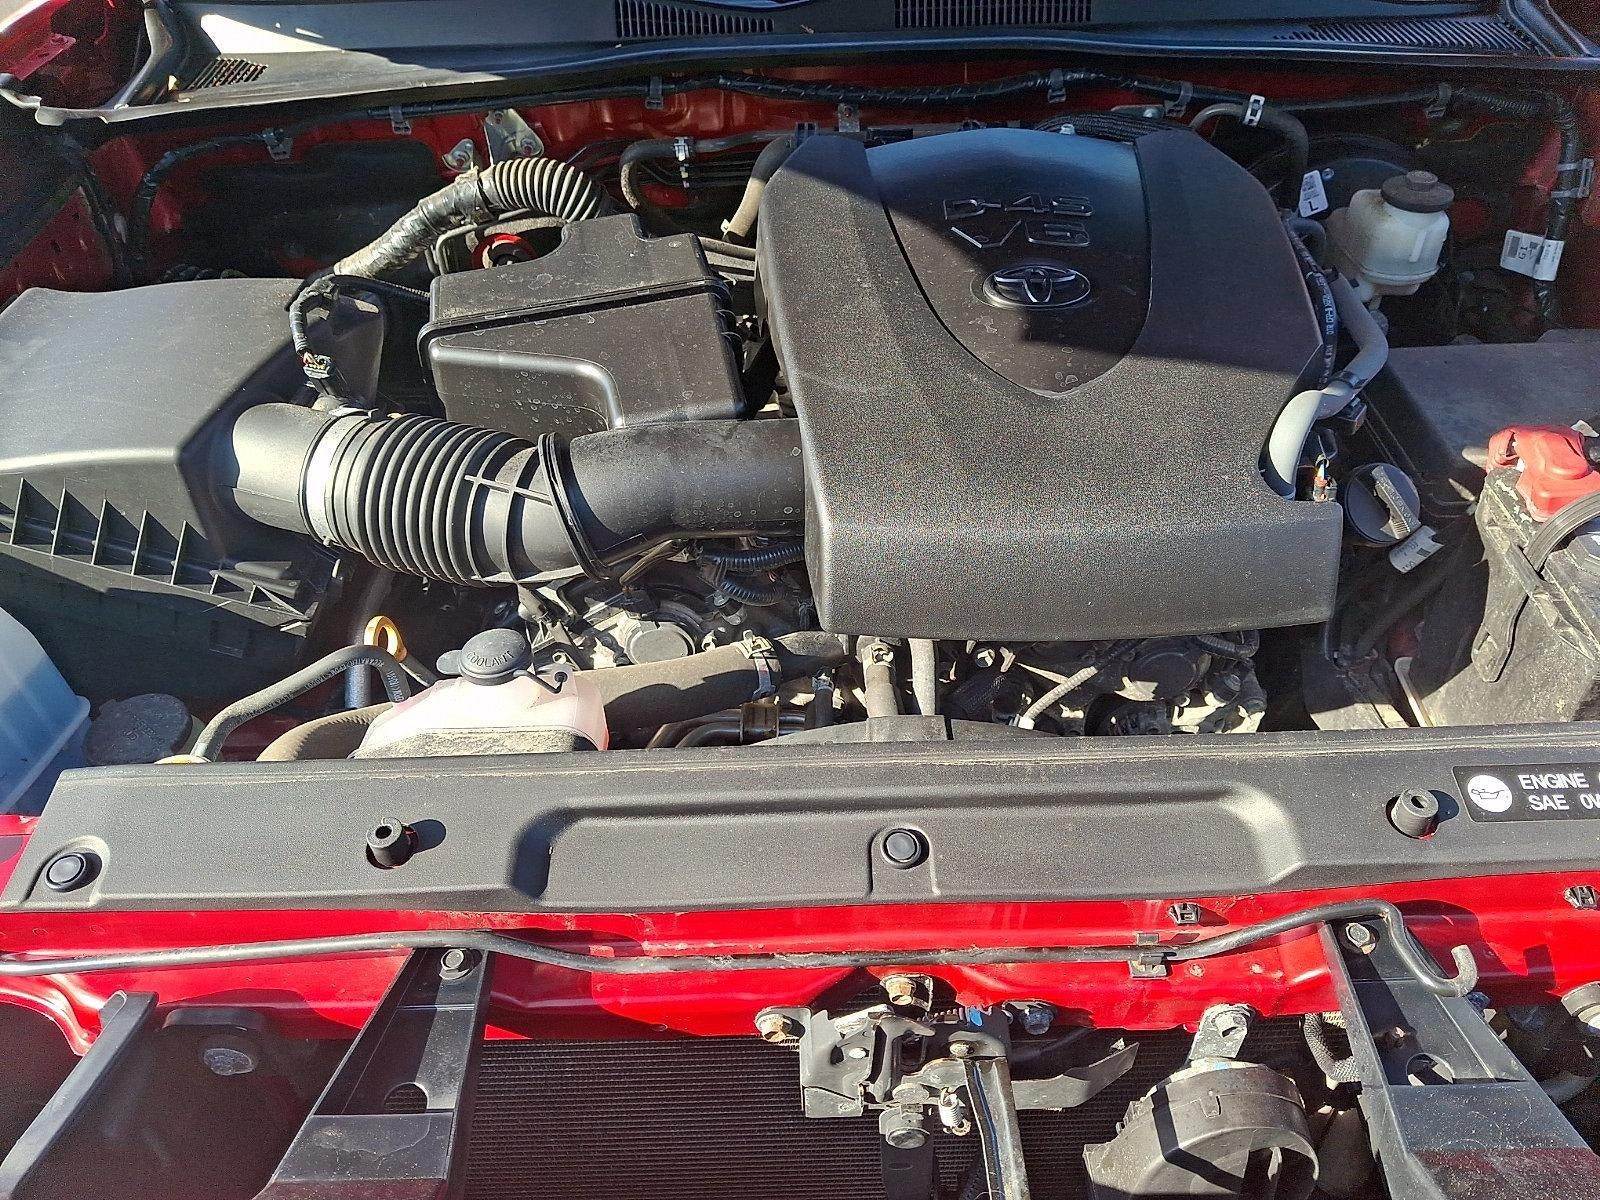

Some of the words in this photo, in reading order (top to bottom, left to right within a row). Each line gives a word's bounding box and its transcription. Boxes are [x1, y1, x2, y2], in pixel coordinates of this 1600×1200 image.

[950, 219, 1092, 248] V6
[466, 650, 515, 669] COOLANT
[1517, 773, 1590, 790] ENGINE
[1528, 794, 1570, 811] SAE
